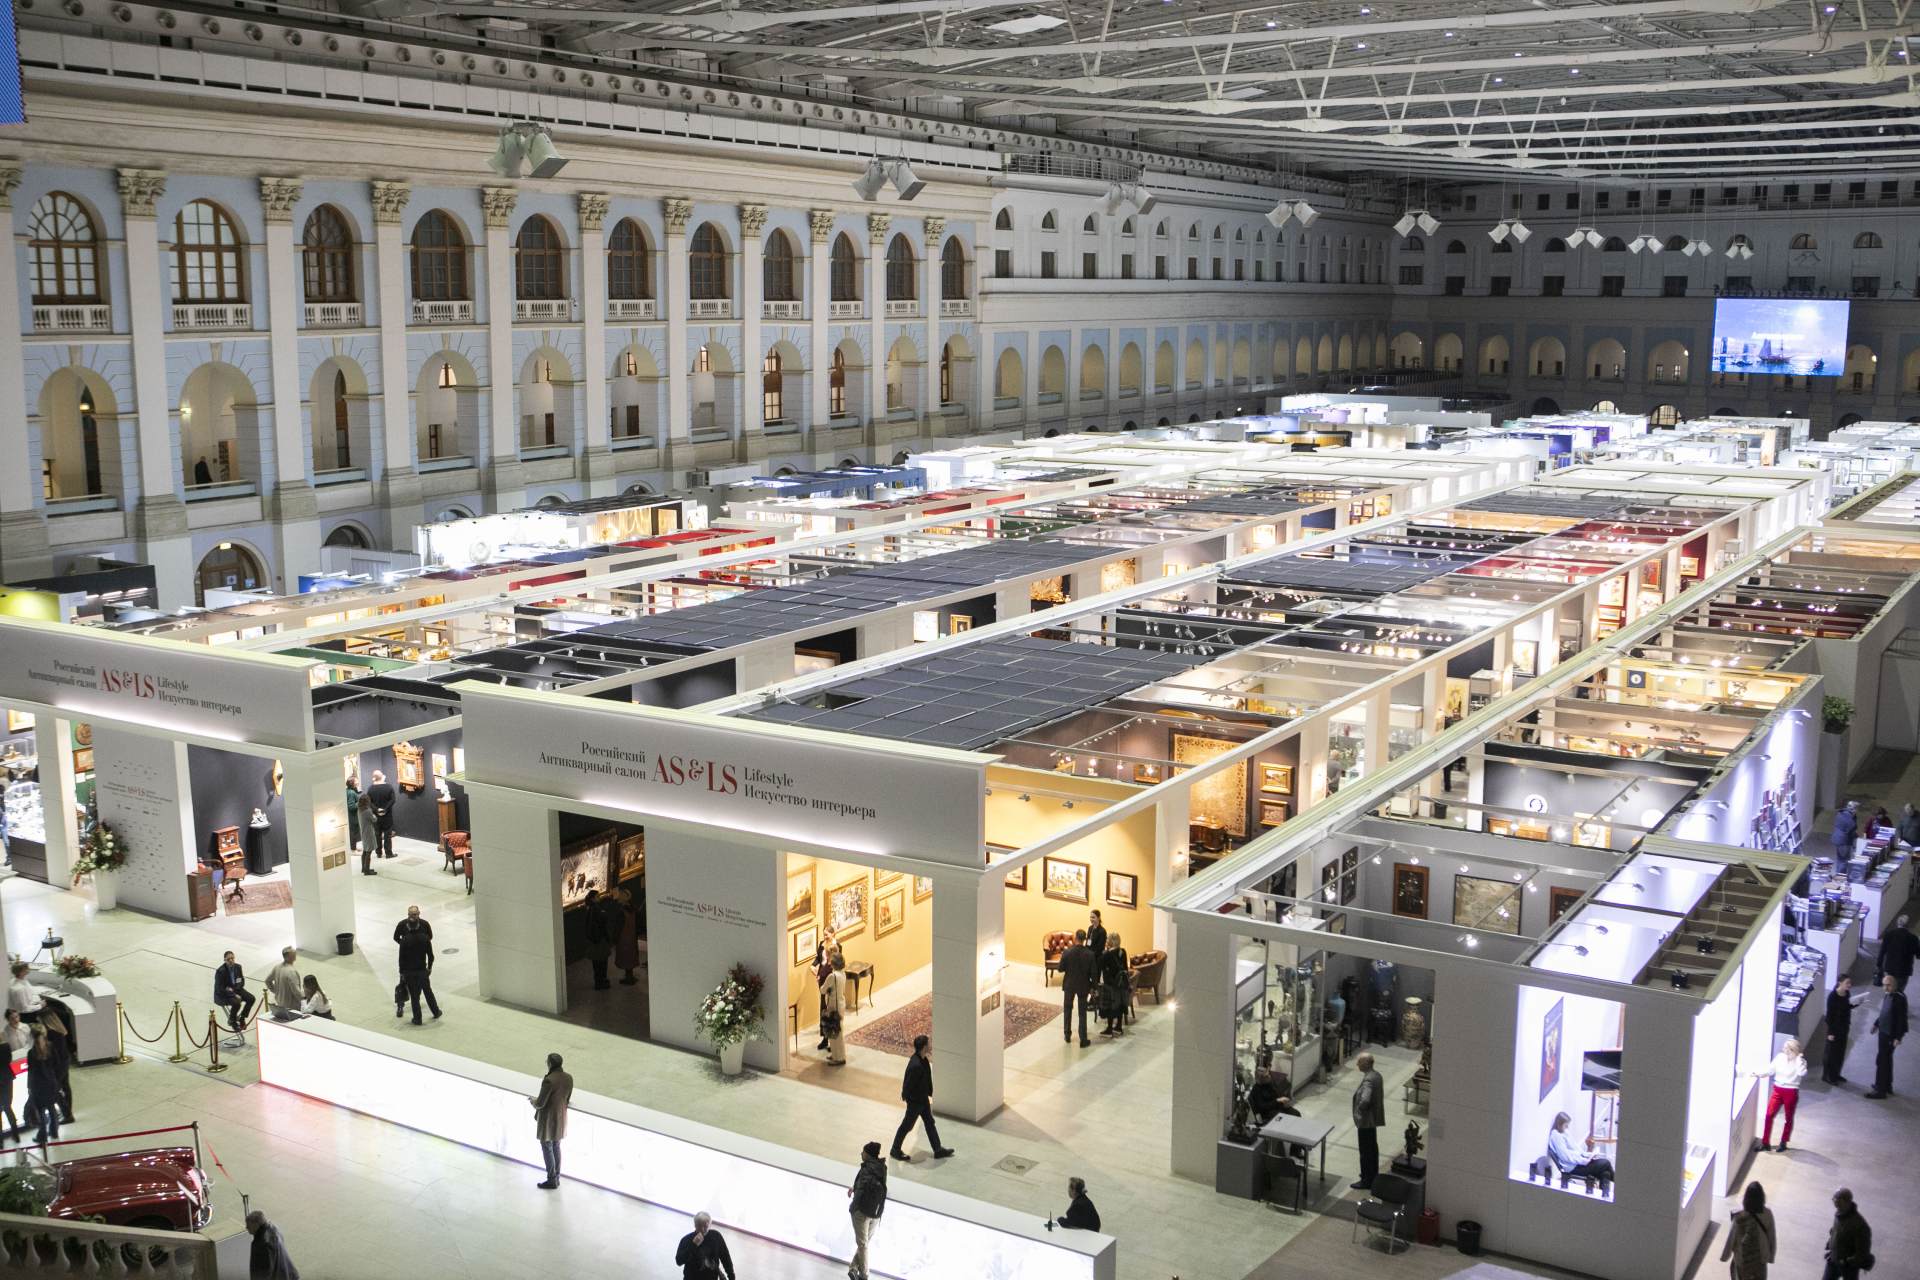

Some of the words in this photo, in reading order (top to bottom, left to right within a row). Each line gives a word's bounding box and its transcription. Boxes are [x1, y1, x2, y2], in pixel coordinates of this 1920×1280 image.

[76, 678, 97, 689] салон
[157, 676, 189, 693] Lifestyle
[157, 690, 199, 707] Искусство
[200, 700, 242, 716] интерьера
[581, 741, 646, 764] Российский
[538, 751, 612, 774] Антикварный
[614, 766, 646, 780] салон
[744, 766, 794, 789] Lifestyle
[744, 783, 807, 806] Искусство
[811, 798, 876, 820] интерьера
